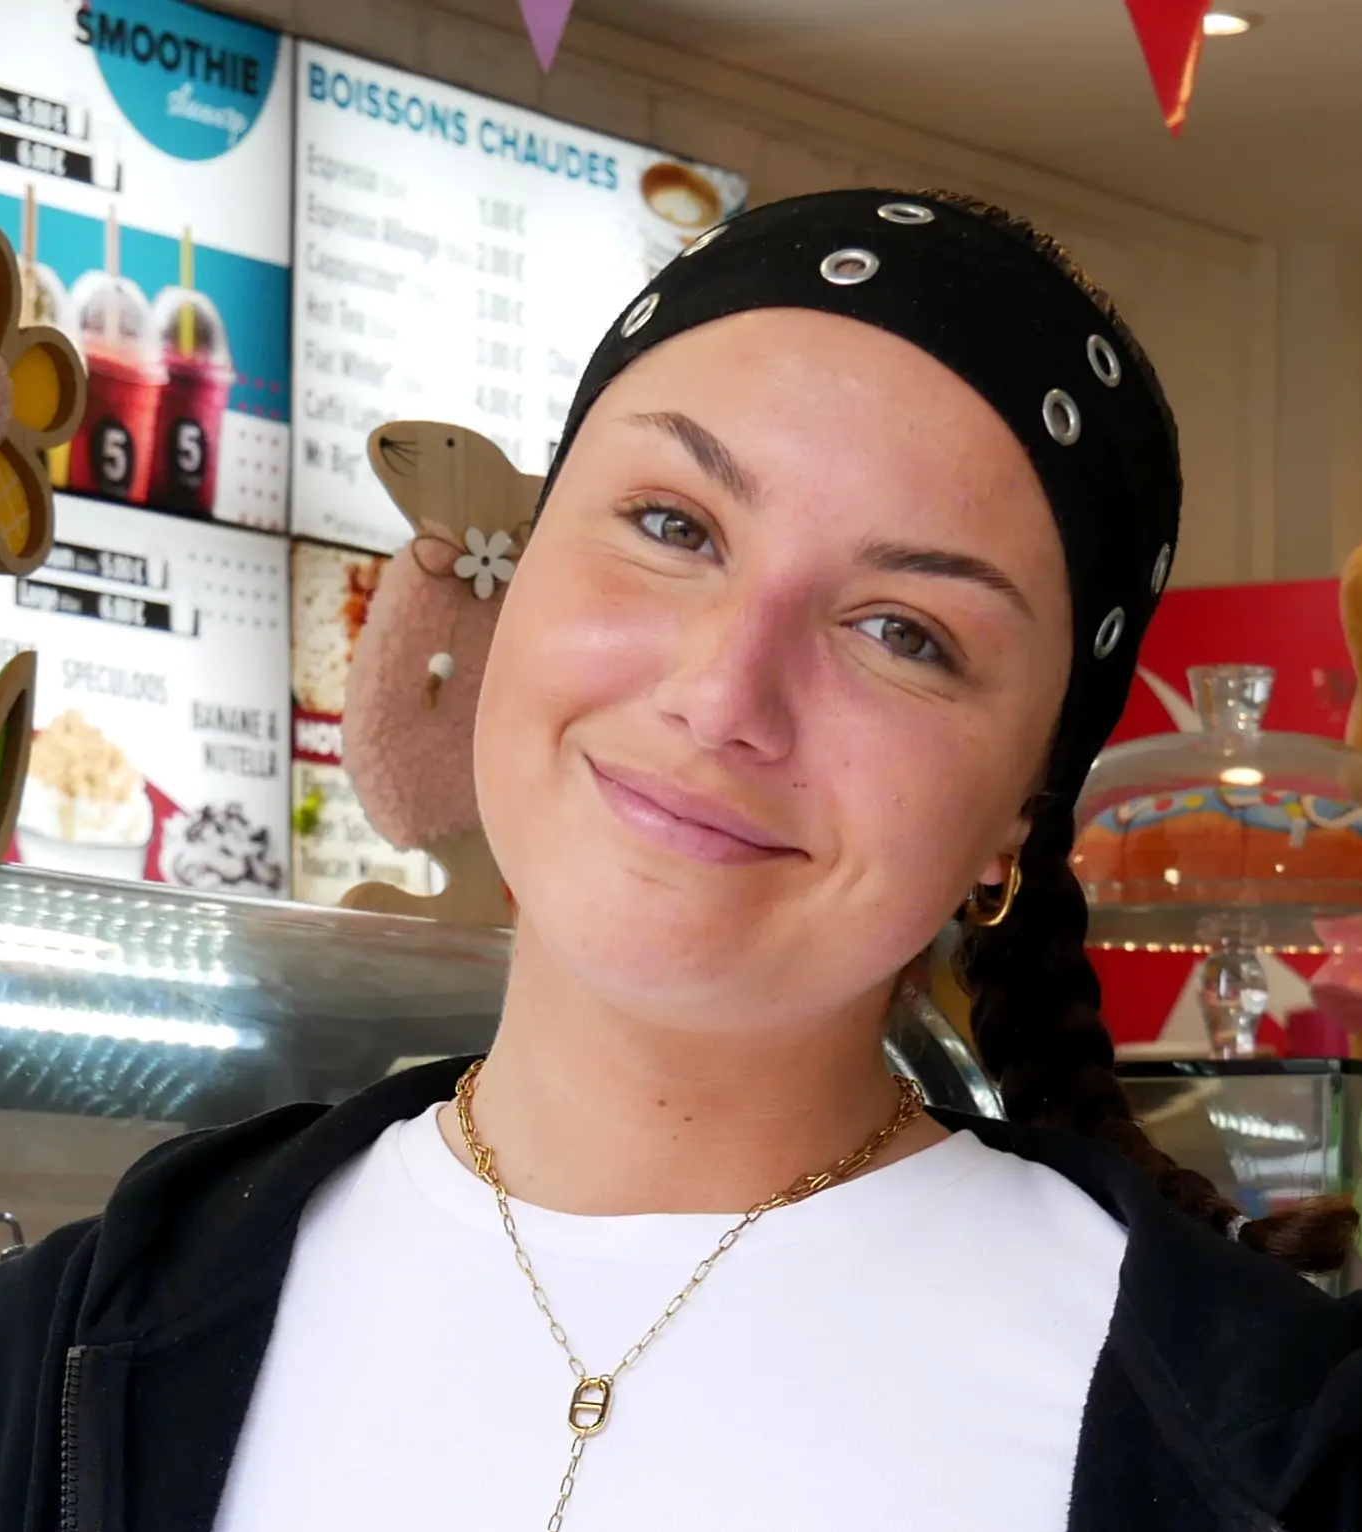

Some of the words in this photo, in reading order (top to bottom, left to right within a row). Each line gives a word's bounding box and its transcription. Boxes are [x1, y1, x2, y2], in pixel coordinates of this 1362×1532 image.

[75, 8, 259, 96] SMOOTHIE
[308, 61, 467, 146] BOISSONS
[479, 120, 618, 191] CHAUDES
[103, 428, 129, 482] 5
[178, 423, 202, 473] 5
